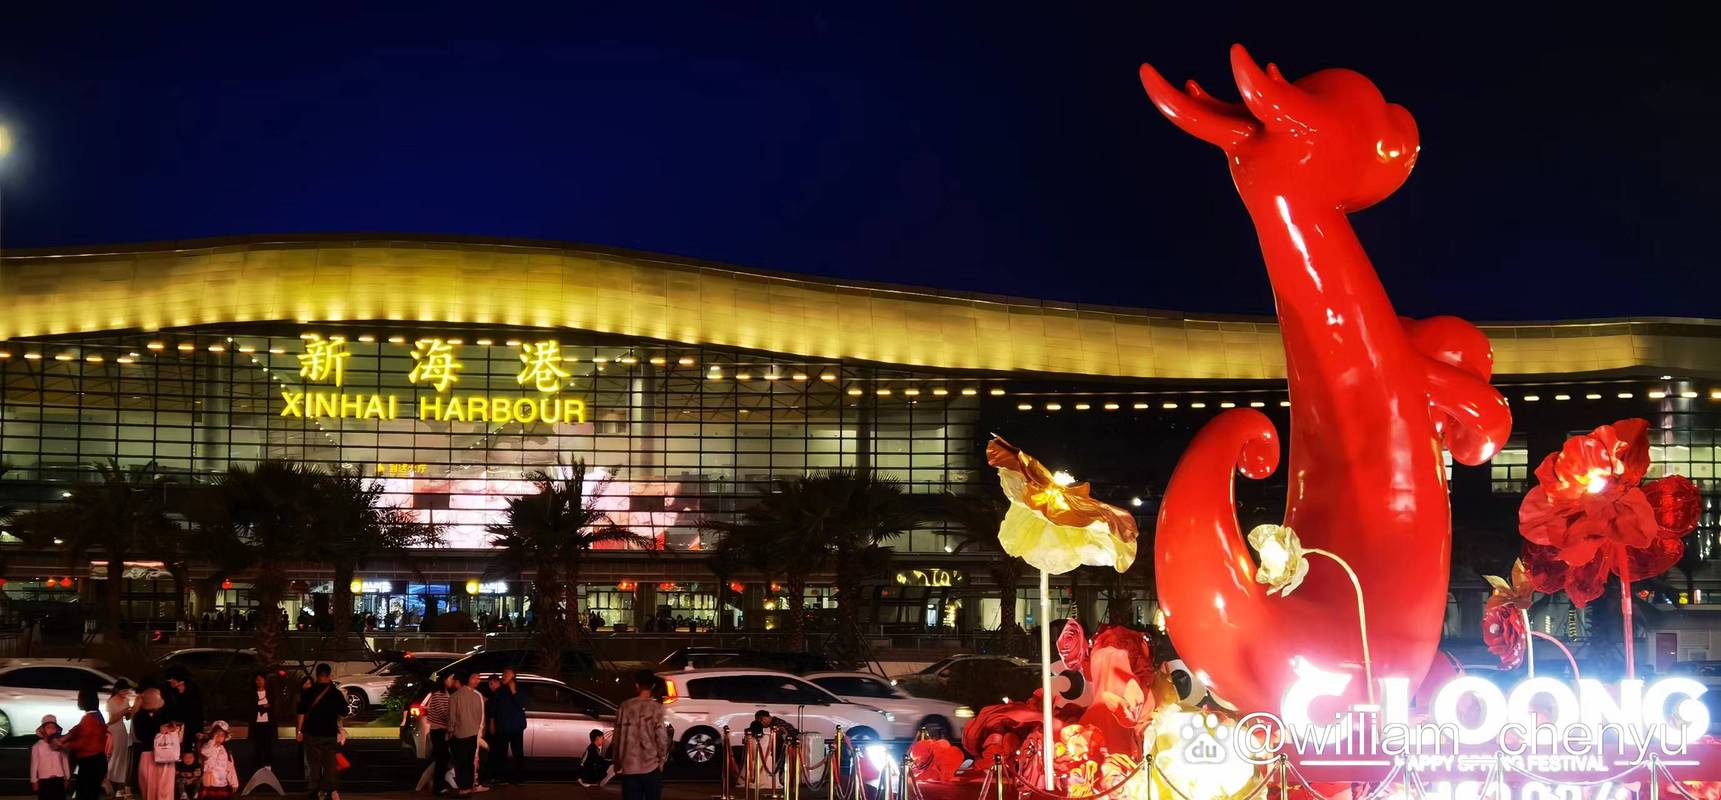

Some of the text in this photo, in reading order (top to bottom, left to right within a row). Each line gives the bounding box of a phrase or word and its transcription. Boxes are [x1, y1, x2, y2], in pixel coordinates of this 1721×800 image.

[297, 336, 572, 393] 新海港
[281, 392, 586, 424] XINHAI HARBOUR
[1527, 755, 1609, 772] FESTIVAL
